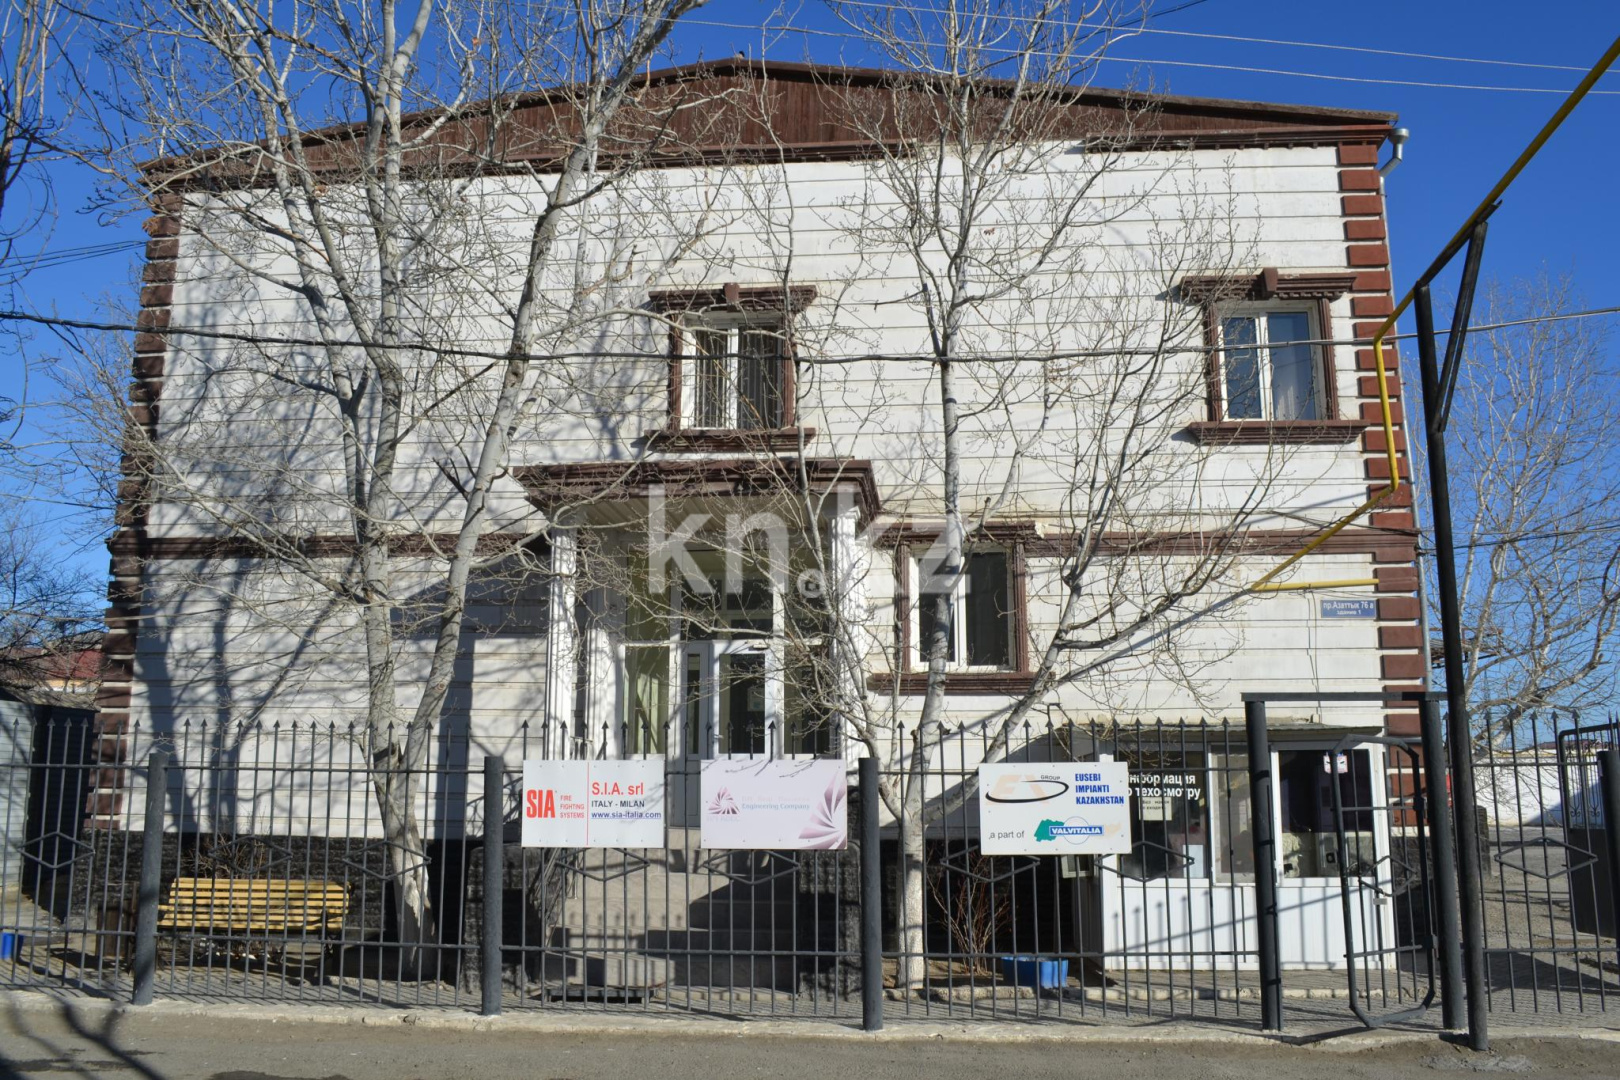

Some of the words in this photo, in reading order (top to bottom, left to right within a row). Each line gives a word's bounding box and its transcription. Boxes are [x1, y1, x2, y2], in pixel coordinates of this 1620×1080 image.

[1075, 773, 1101, 782] EUSEBI
[591, 782, 624, 795] S.I.A.
[627, 782, 644, 795] srl
[1075, 785, 1110, 793] IMPIANTI
[526, 789, 555, 819] SIA
[591, 800, 612, 808] ITALY
[619, 800, 645, 808] MILAN
[1076, 796, 1125, 805] KAZAKHSTAN
[591, 810, 662, 819] www.sia-italia.com
[997, 831, 1014, 840] part
[1016, 830, 1025, 839] of
